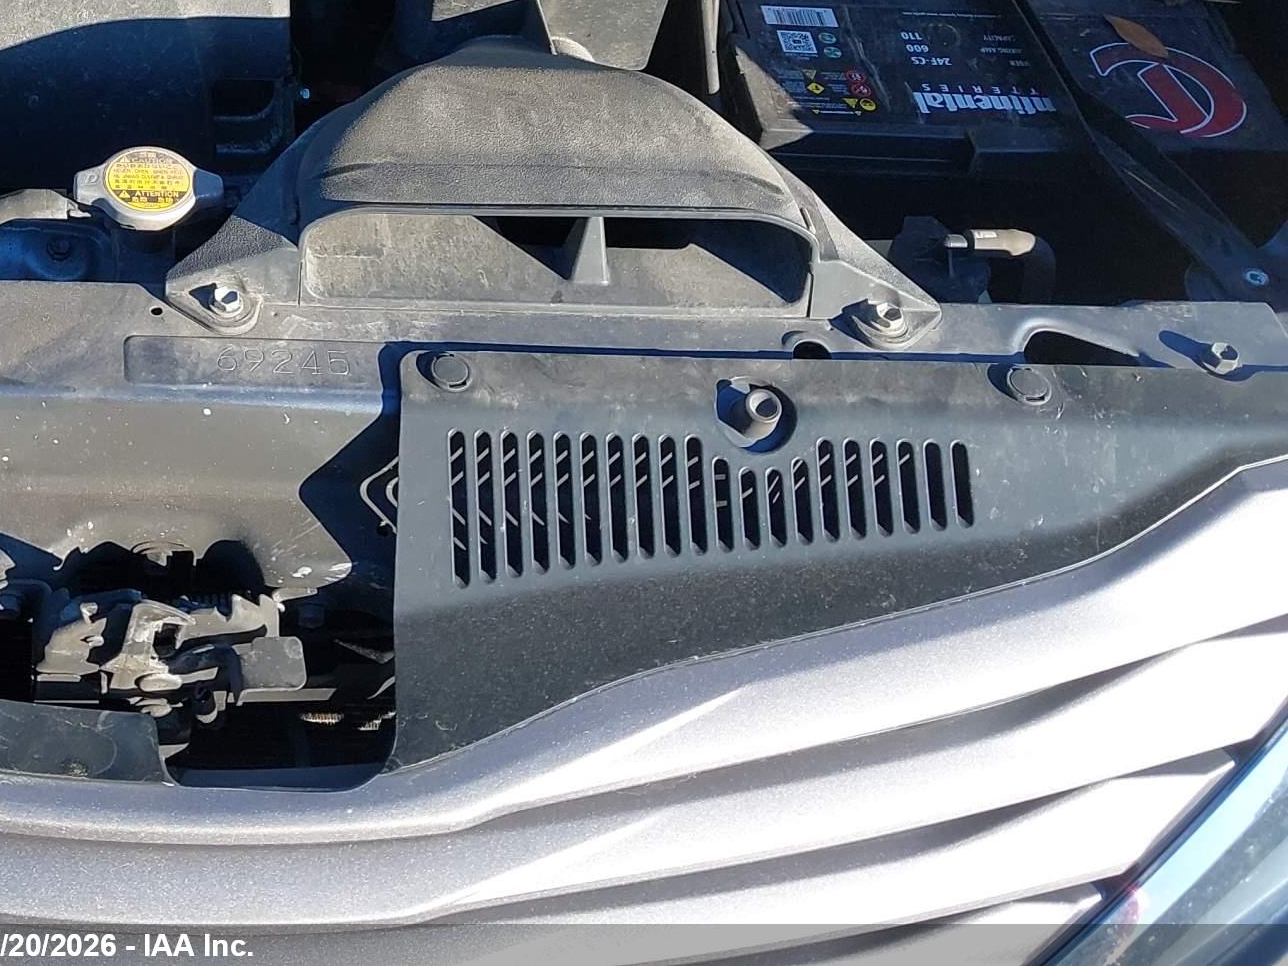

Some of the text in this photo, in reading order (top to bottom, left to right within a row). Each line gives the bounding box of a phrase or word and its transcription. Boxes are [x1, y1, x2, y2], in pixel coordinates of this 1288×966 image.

[900, 31, 923, 40] 110
[905, 44, 930, 53] 600
[911, 56, 953, 66] 24F-CS
[912, 91, 1057, 115] ntinental
[134, 190, 179, 198] ATTENTION
[215, 344, 351, 376] 69245
